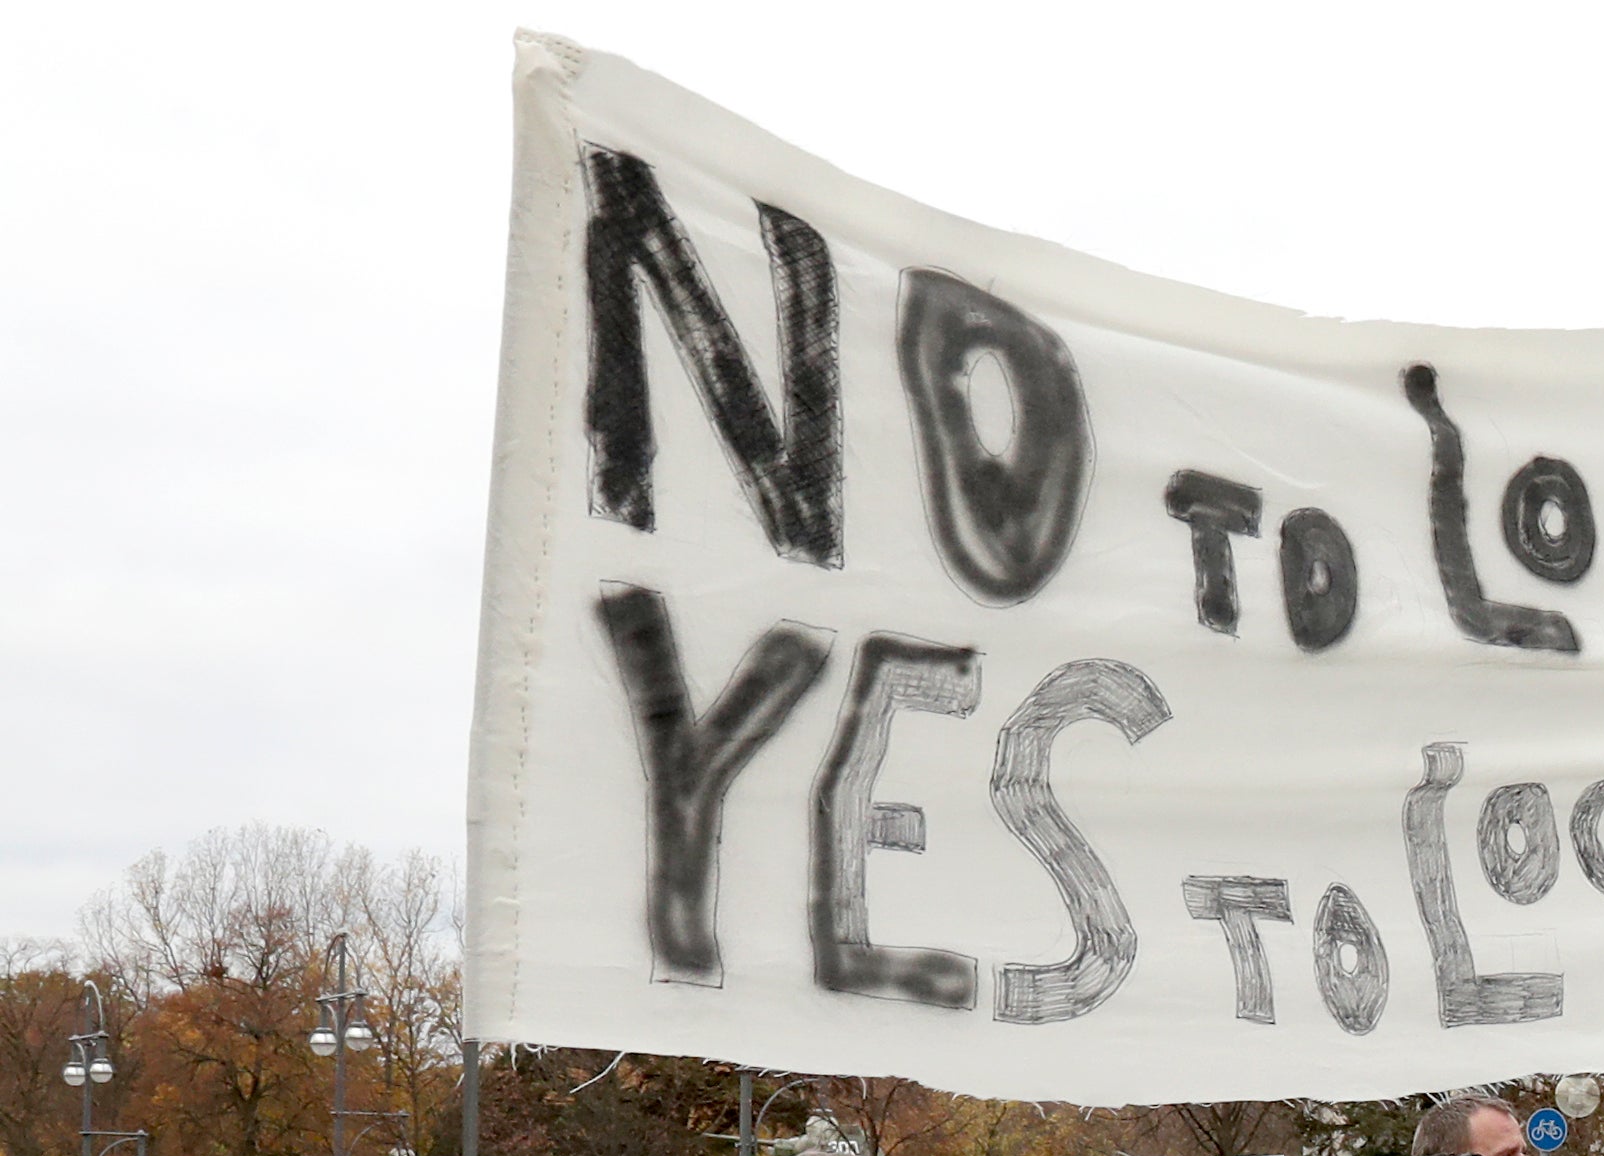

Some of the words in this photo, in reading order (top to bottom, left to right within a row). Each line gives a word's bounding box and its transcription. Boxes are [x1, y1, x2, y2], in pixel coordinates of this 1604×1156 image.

[584, 140, 1096, 610] NO
[1165, 470, 1358, 653] TO
[594, 580, 1173, 1025] YES
[1181, 874, 1390, 1037] TO
